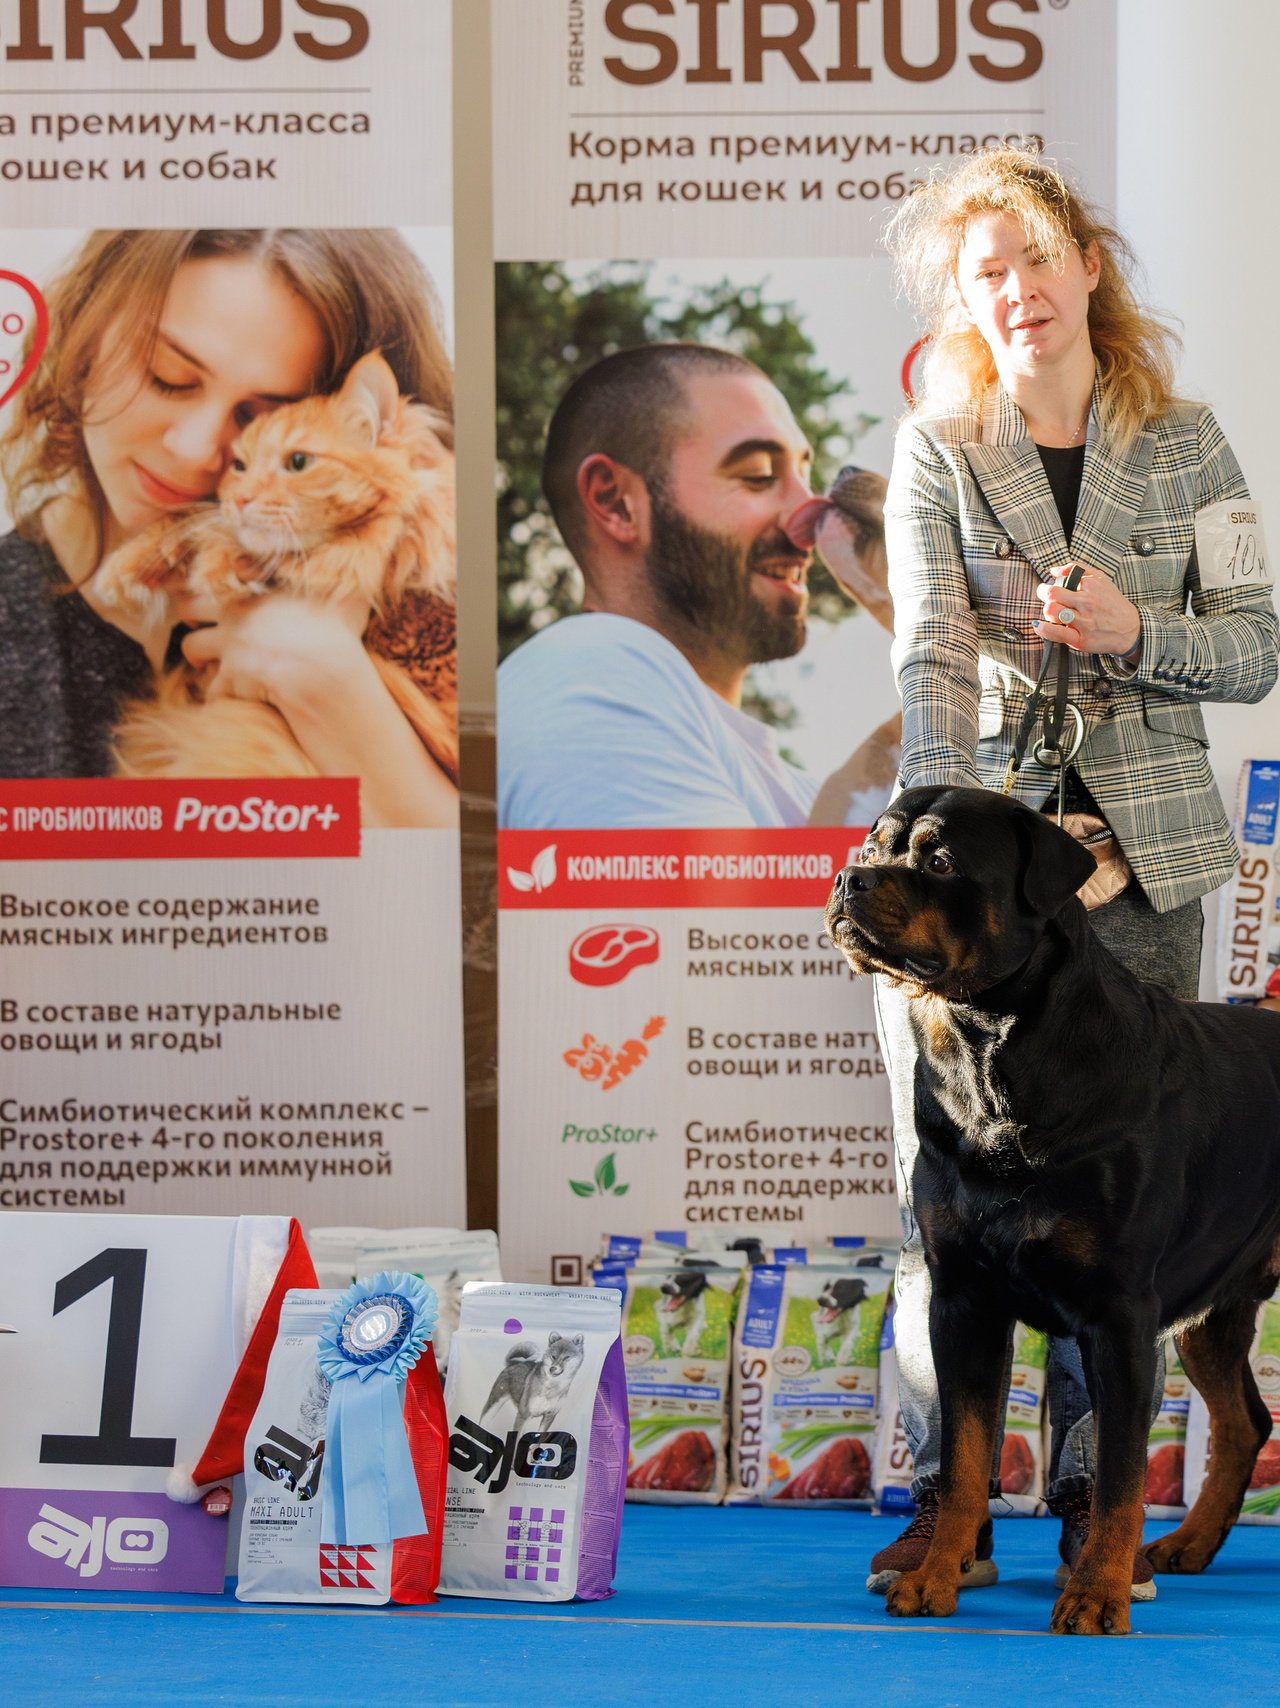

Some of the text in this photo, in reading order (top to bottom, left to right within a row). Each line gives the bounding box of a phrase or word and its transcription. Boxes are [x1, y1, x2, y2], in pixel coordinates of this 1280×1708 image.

[603, 0, 1044, 86] SIRIUS
[31, 110, 371, 142] премиум-класса
[569, 131, 695, 164] Корма
[1, 150, 277, 181] ошек и собак
[571, 180, 643, 208] для
[658, 177, 787, 203] кошек
[800, 178, 823, 201] и
[1230, 512, 1257, 525] SIRIUS
[13, 805, 163, 832] ПРОБИОТИКОВ
[174, 797, 340, 833] ProStor+
[566, 856, 680, 882] КОМПЛЕКС
[684, 854, 833, 880] ПРОБИОТИКОВ
[0, 894, 321, 922] Высокое содержание
[1230, 857, 1269, 988] SIRIUS
[0, 924, 328, 950] мясных ингредиентов
[687, 928, 810, 951] Высокое
[687, 959, 795, 977] мясных
[0, 999, 342, 1027] В составе натуральные
[0, 1032, 223, 1055] овощи и ягоды
[688, 1028, 705, 1050] В
[713, 1031, 818, 1050] составе
[687, 1056, 779, 1081] овощи
[786, 1056, 802, 1076] и
[0, 1097, 405, 1124] Симбиотический комплекс
[0, 1126, 383, 1151] Prostore+ 4-го поколения
[561, 1123, 659, 1144] ProStor+
[0, 1151, 393, 1184] для поддержки иммунной
[686, 1146, 888, 1170] Prostore+ 4-го
[0, 1187, 126, 1208] системы
[685, 1177, 736, 1201] для
[685, 1203, 804, 1223] системы
[39, 1247, 176, 1467] 1
[740, 1358, 767, 1495] SIRIUS
[516, 1481, 541, 1489] technology
[250, 1505, 314, 1518] MAXI ADULT
